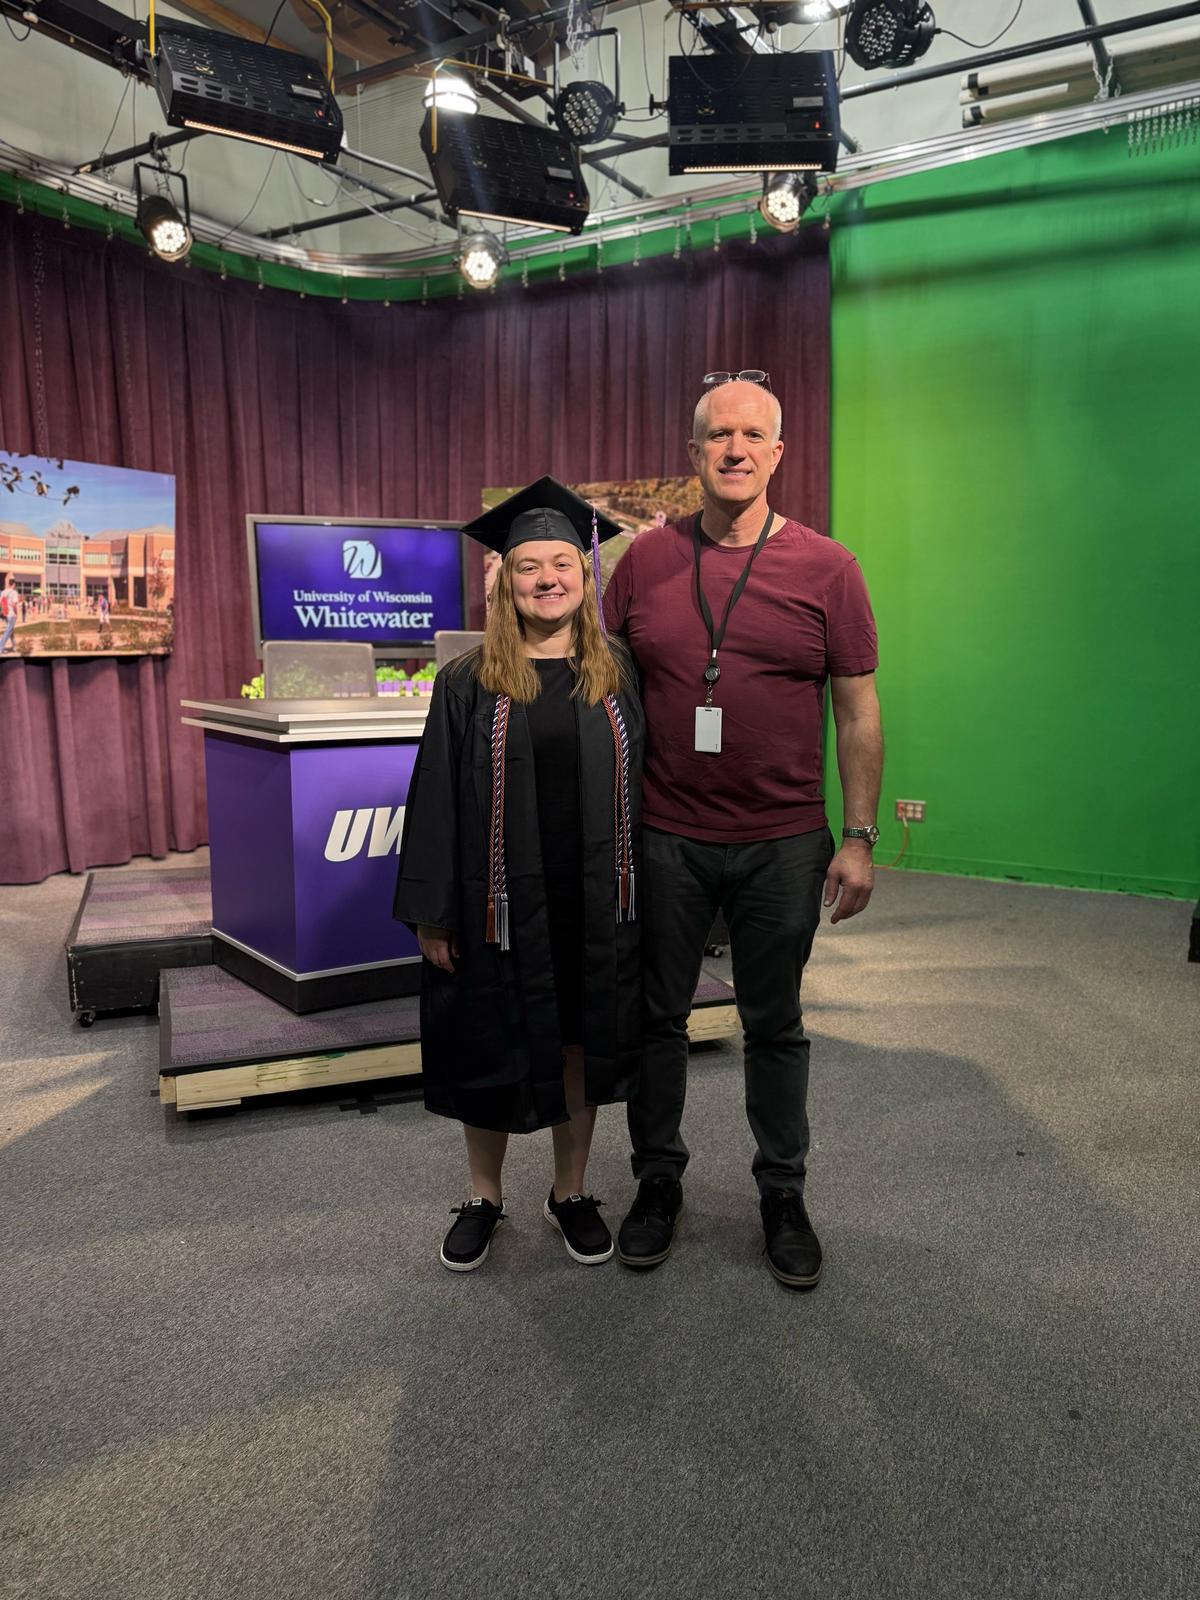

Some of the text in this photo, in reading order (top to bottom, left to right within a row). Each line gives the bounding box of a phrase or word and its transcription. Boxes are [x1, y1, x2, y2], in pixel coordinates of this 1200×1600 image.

[293, 590, 433, 605] University of Wisconsin
[293, 605, 434, 628] Whitewater
